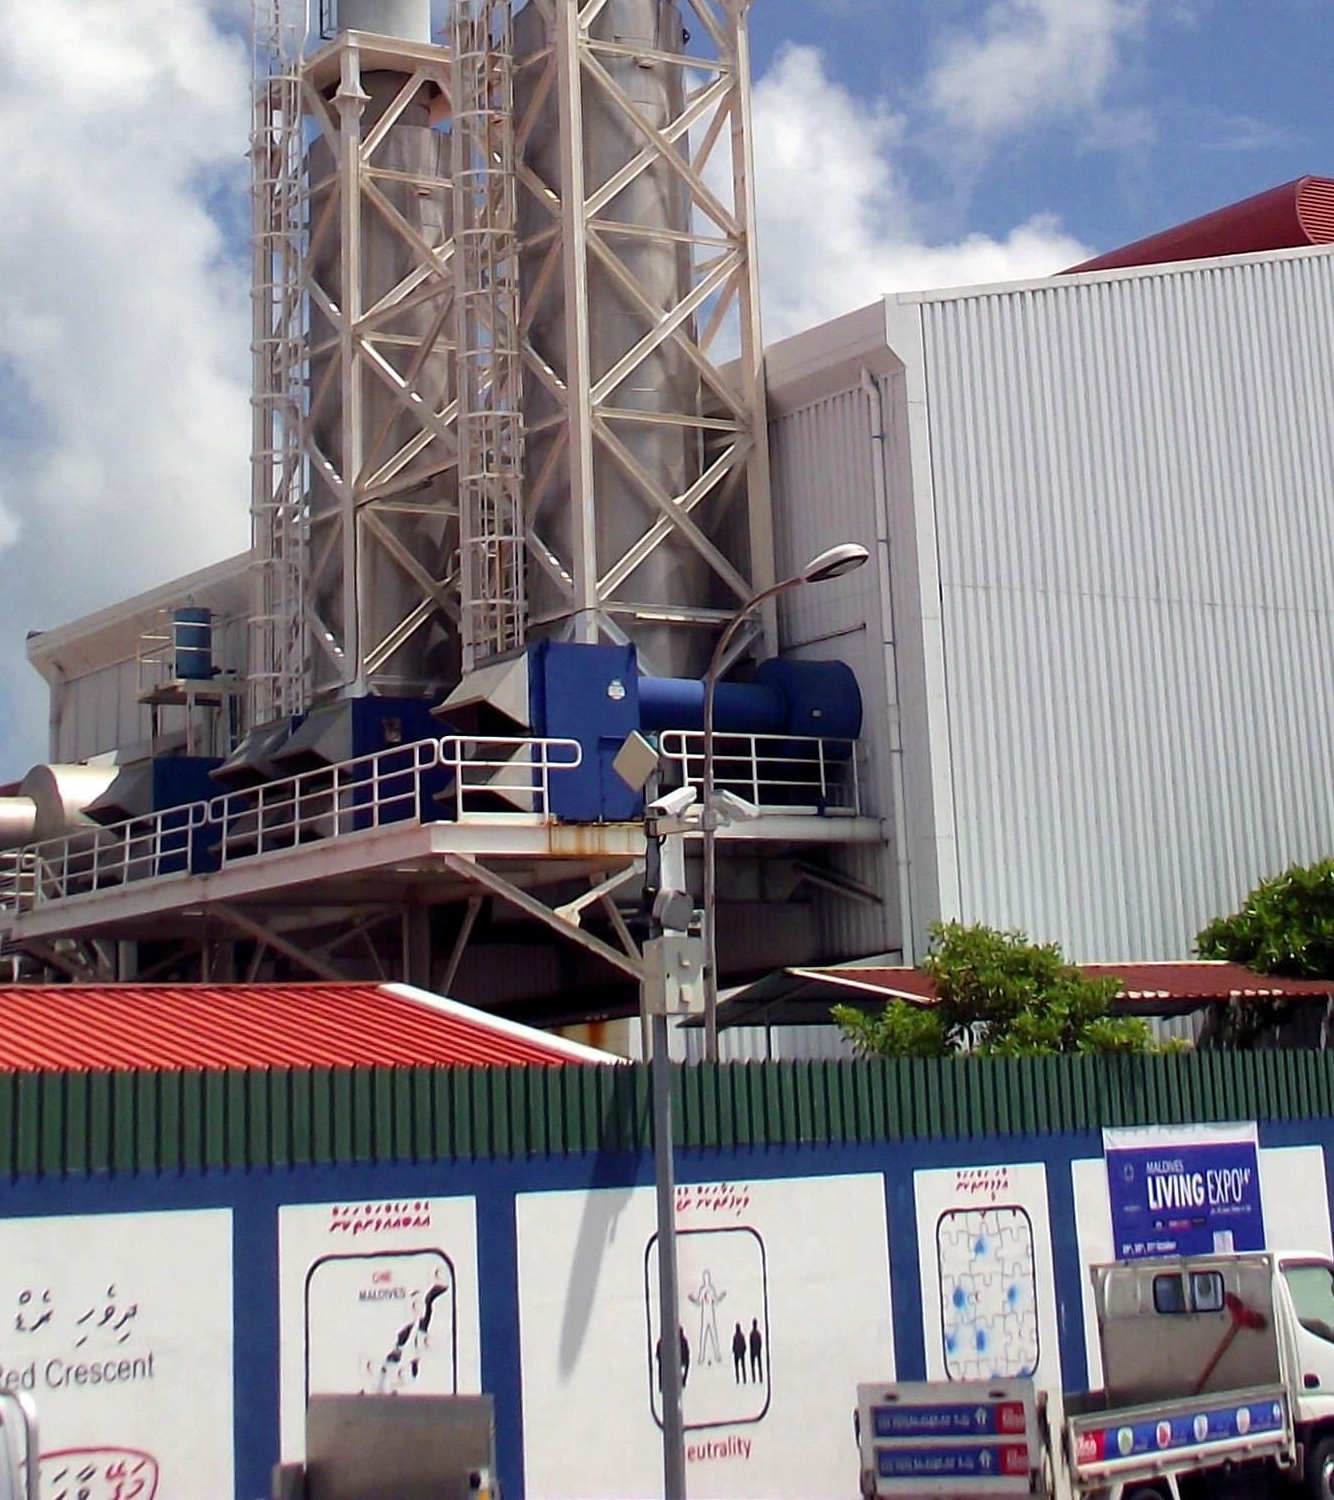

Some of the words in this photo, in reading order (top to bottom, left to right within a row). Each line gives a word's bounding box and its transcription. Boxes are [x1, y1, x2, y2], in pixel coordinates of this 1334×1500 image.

[1147, 1159, 1184, 1173] MALDIVES
[1147, 1172, 1205, 1210] LIVING
[45, 1350, 155, 1389] Crescent
[687, 1435, 752, 1461] eutrality
